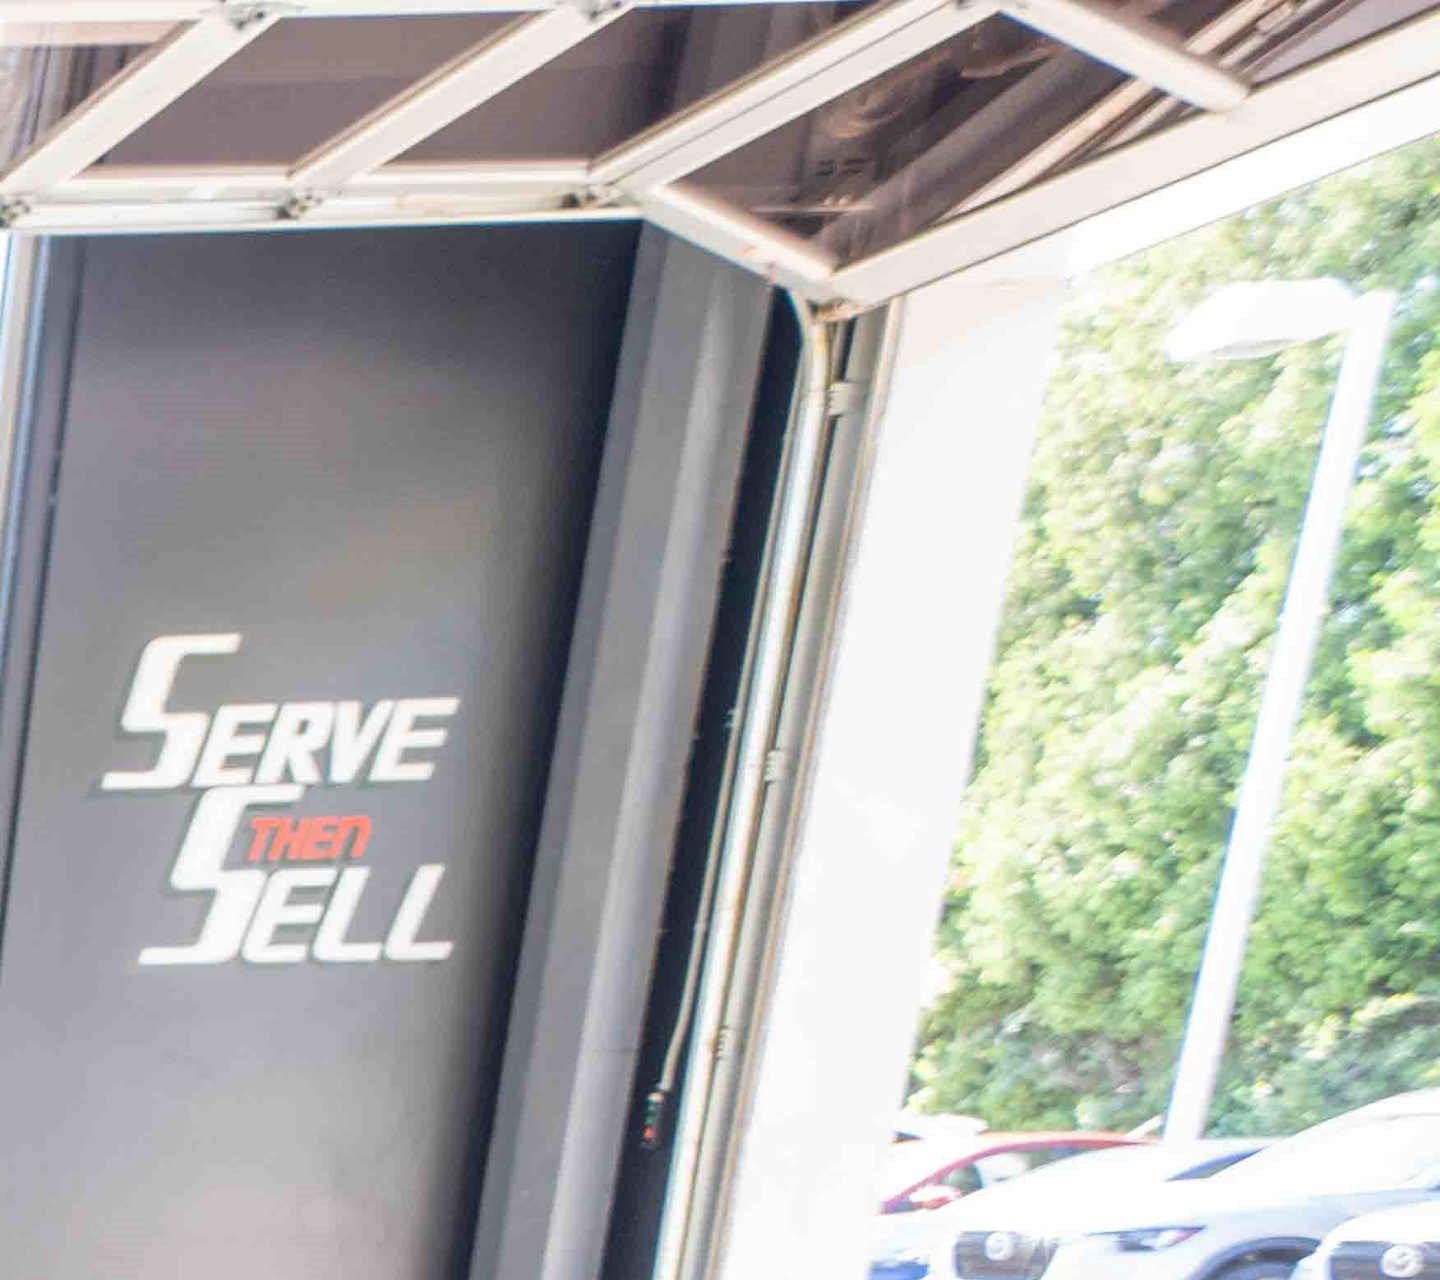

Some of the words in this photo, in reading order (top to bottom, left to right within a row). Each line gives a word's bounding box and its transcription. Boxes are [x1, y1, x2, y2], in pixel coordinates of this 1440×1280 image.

[101, 632, 461, 790] SERVE
[137, 783, 455, 966] SELL
[246, 815, 372, 862] THEN
